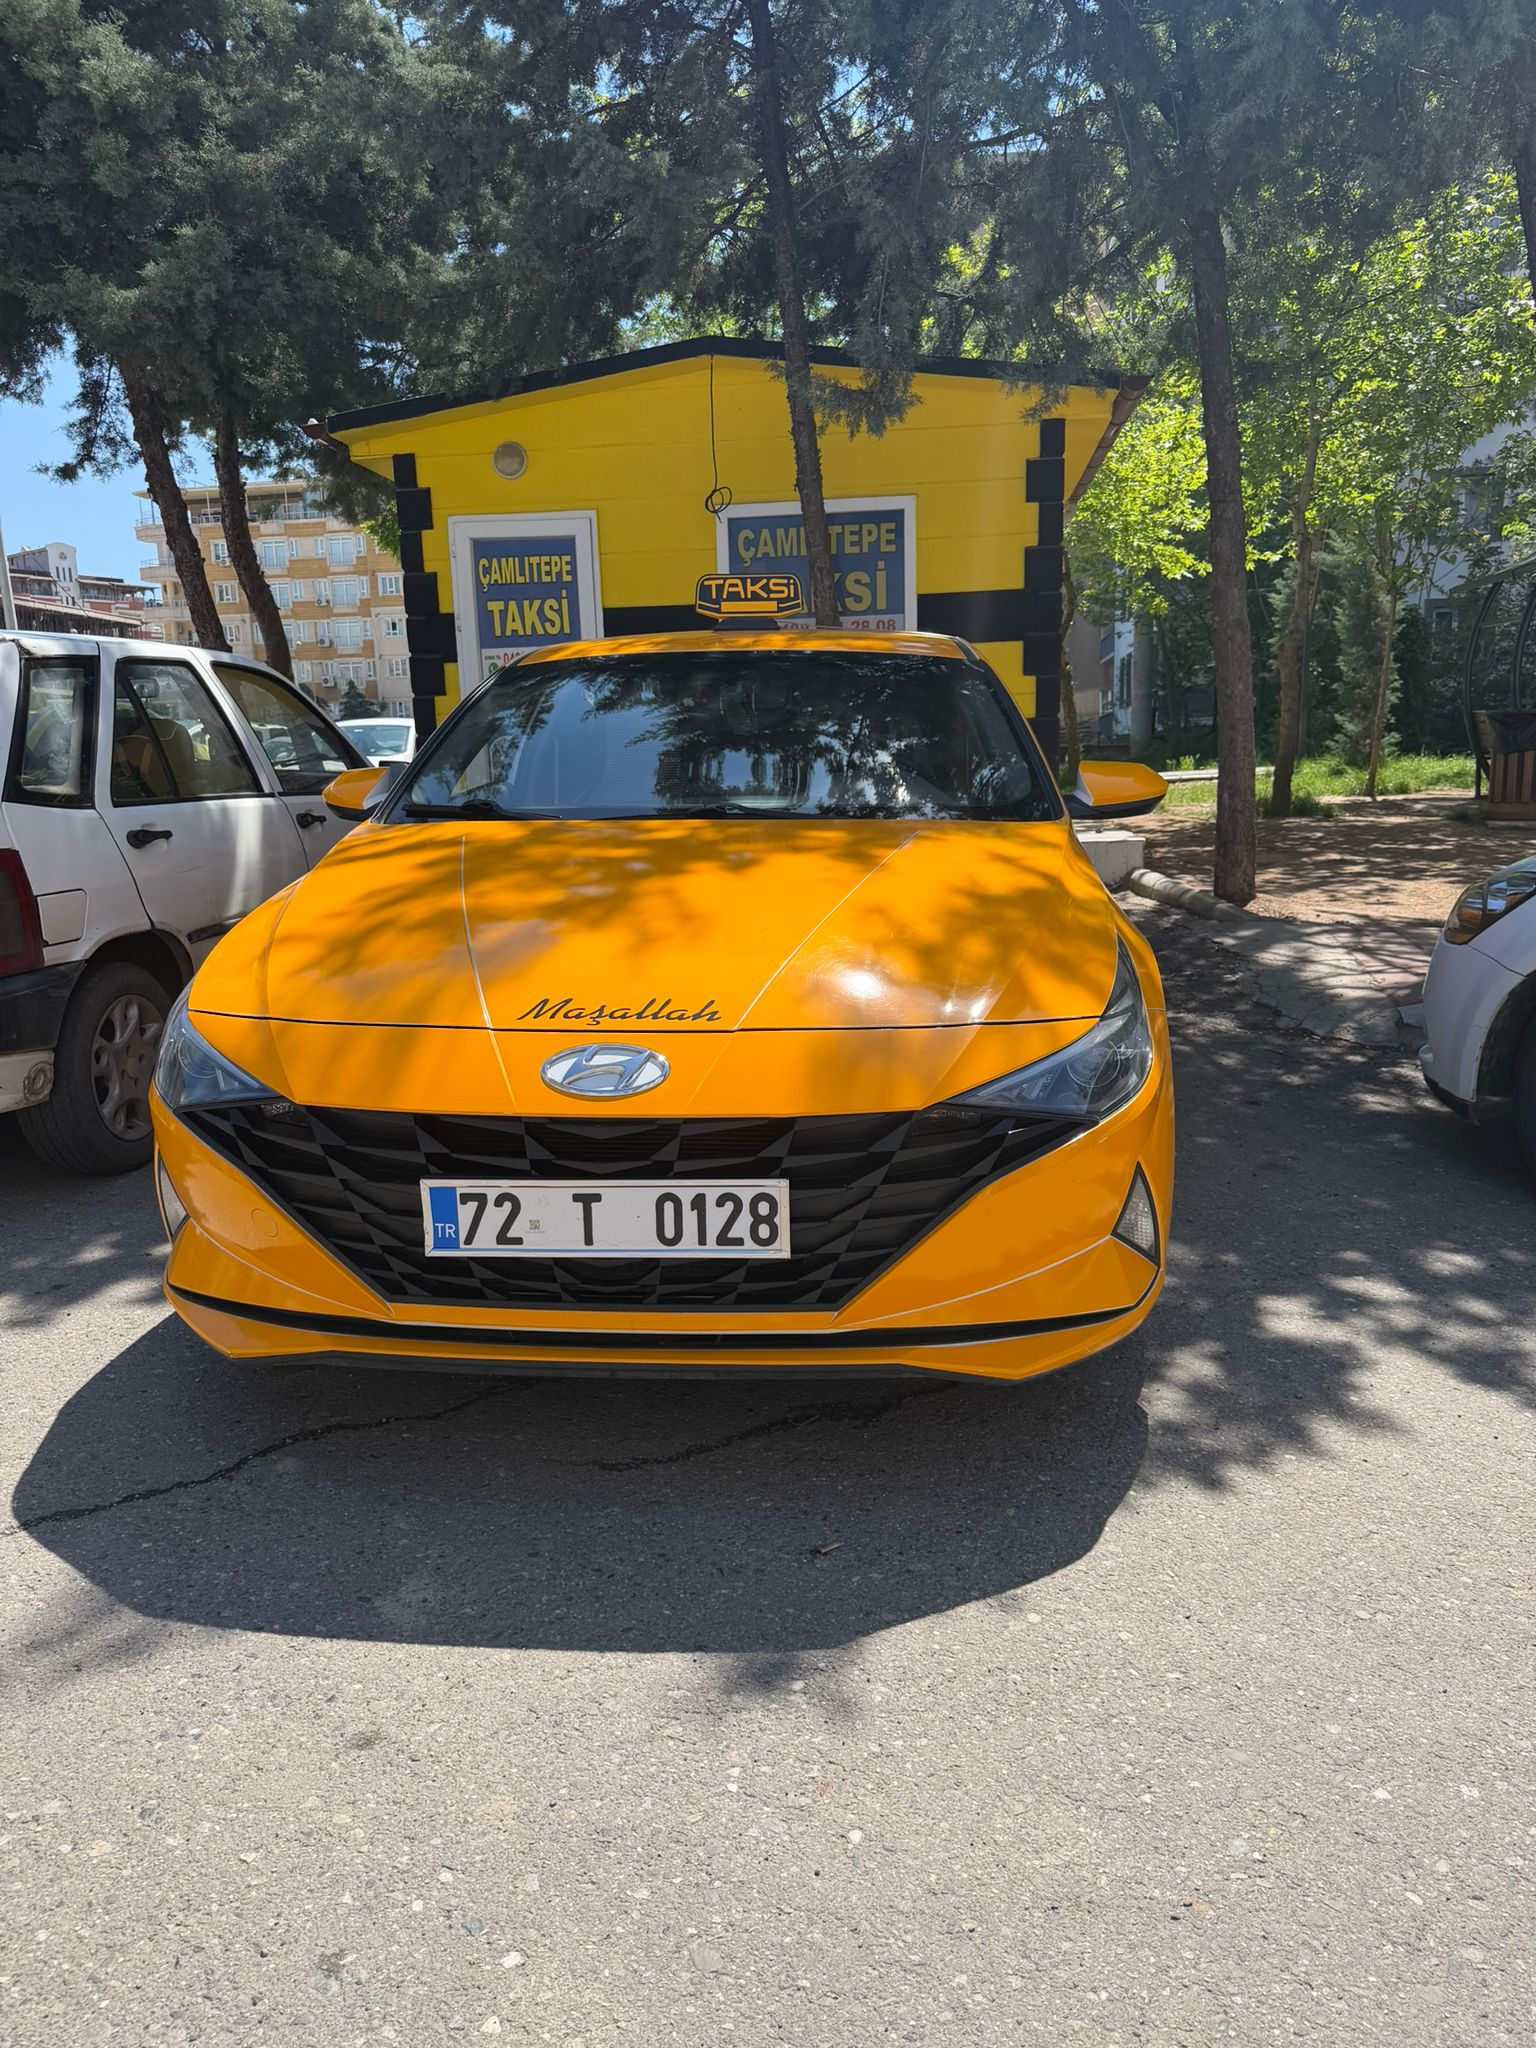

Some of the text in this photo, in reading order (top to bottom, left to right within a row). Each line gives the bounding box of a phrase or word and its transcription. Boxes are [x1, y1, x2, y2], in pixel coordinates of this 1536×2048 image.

[737, 522, 896, 567] ÇAMTEPE
[478, 555, 572, 592] ÇAMLITEPE
[487, 589, 571, 637] TAKSİ
[516, 998, 721, 1026] Maşallah
[434, 1192, 779, 1247] TR 72 T 0128
